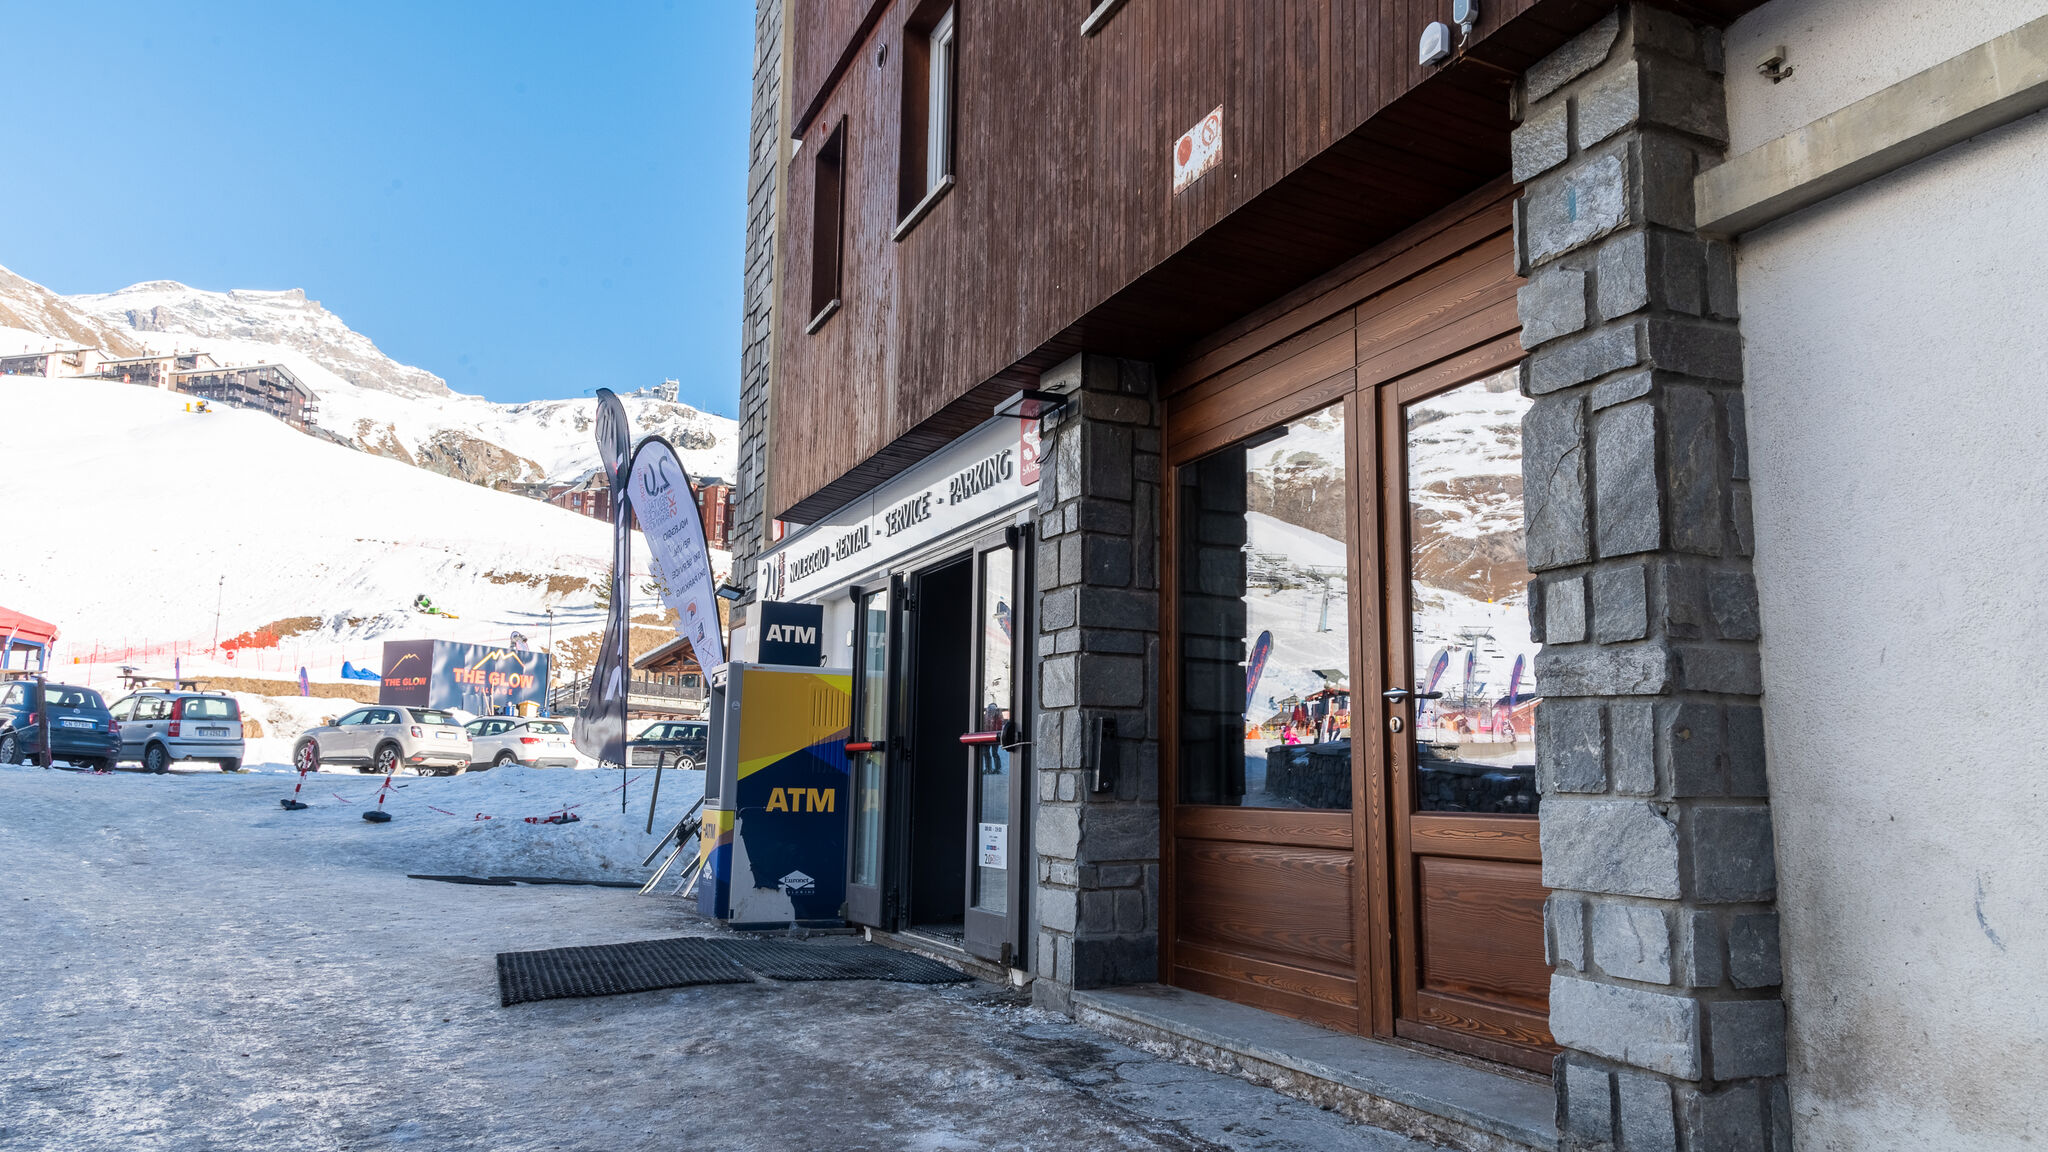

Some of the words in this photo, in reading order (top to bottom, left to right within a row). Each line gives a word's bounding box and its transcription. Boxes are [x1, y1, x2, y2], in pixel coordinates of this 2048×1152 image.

[789, 545, 830, 584] NOLEGGIO
[835, 524, 872, 562] RENTAL
[885, 491, 932, 537] SERVICE
[949, 448, 1014, 506] PARKING
[766, 623, 816, 645] ATM
[384, 678, 400, 687] THE
[402, 676, 427, 687] GLOW
[453, 667, 486, 685] THE
[488, 671, 535, 690] GLOW
[766, 787, 836, 813] ATM
[784, 875, 809, 884] Euronet
